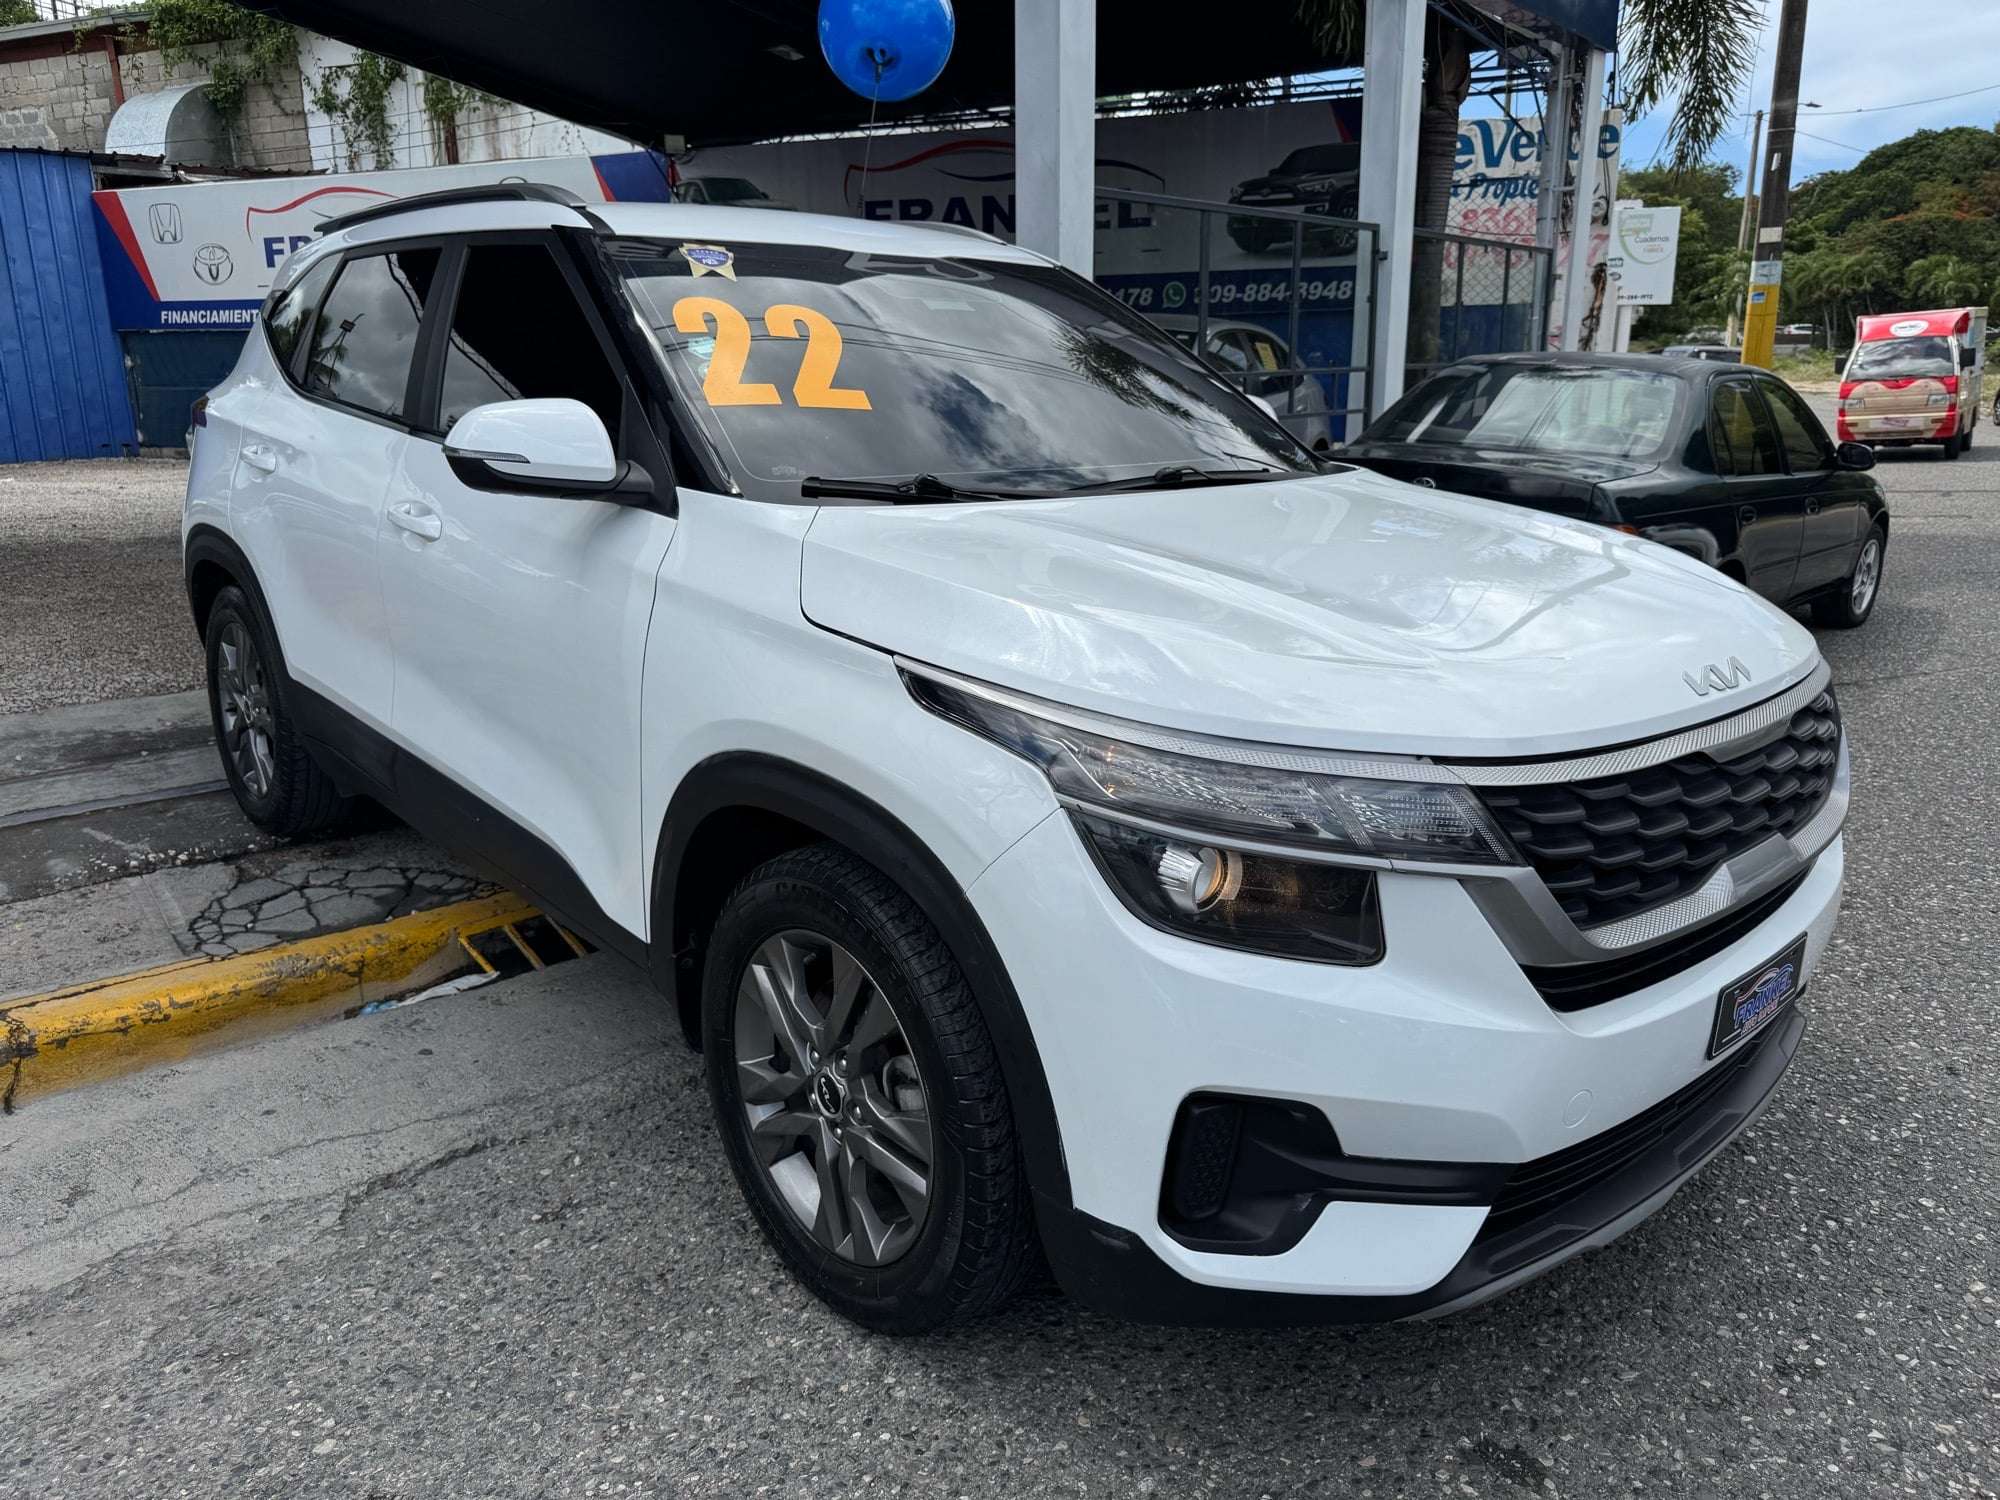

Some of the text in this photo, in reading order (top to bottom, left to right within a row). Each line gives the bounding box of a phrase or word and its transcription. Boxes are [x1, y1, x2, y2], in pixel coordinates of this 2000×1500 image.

[1453, 118, 1620, 170] eVee
[864, 195, 1152, 234] FRANEL
[160, 308, 262, 325] FINANCIAMIENT
[672, 296, 873, 410] 22
[1681, 656, 1752, 697] KIA
